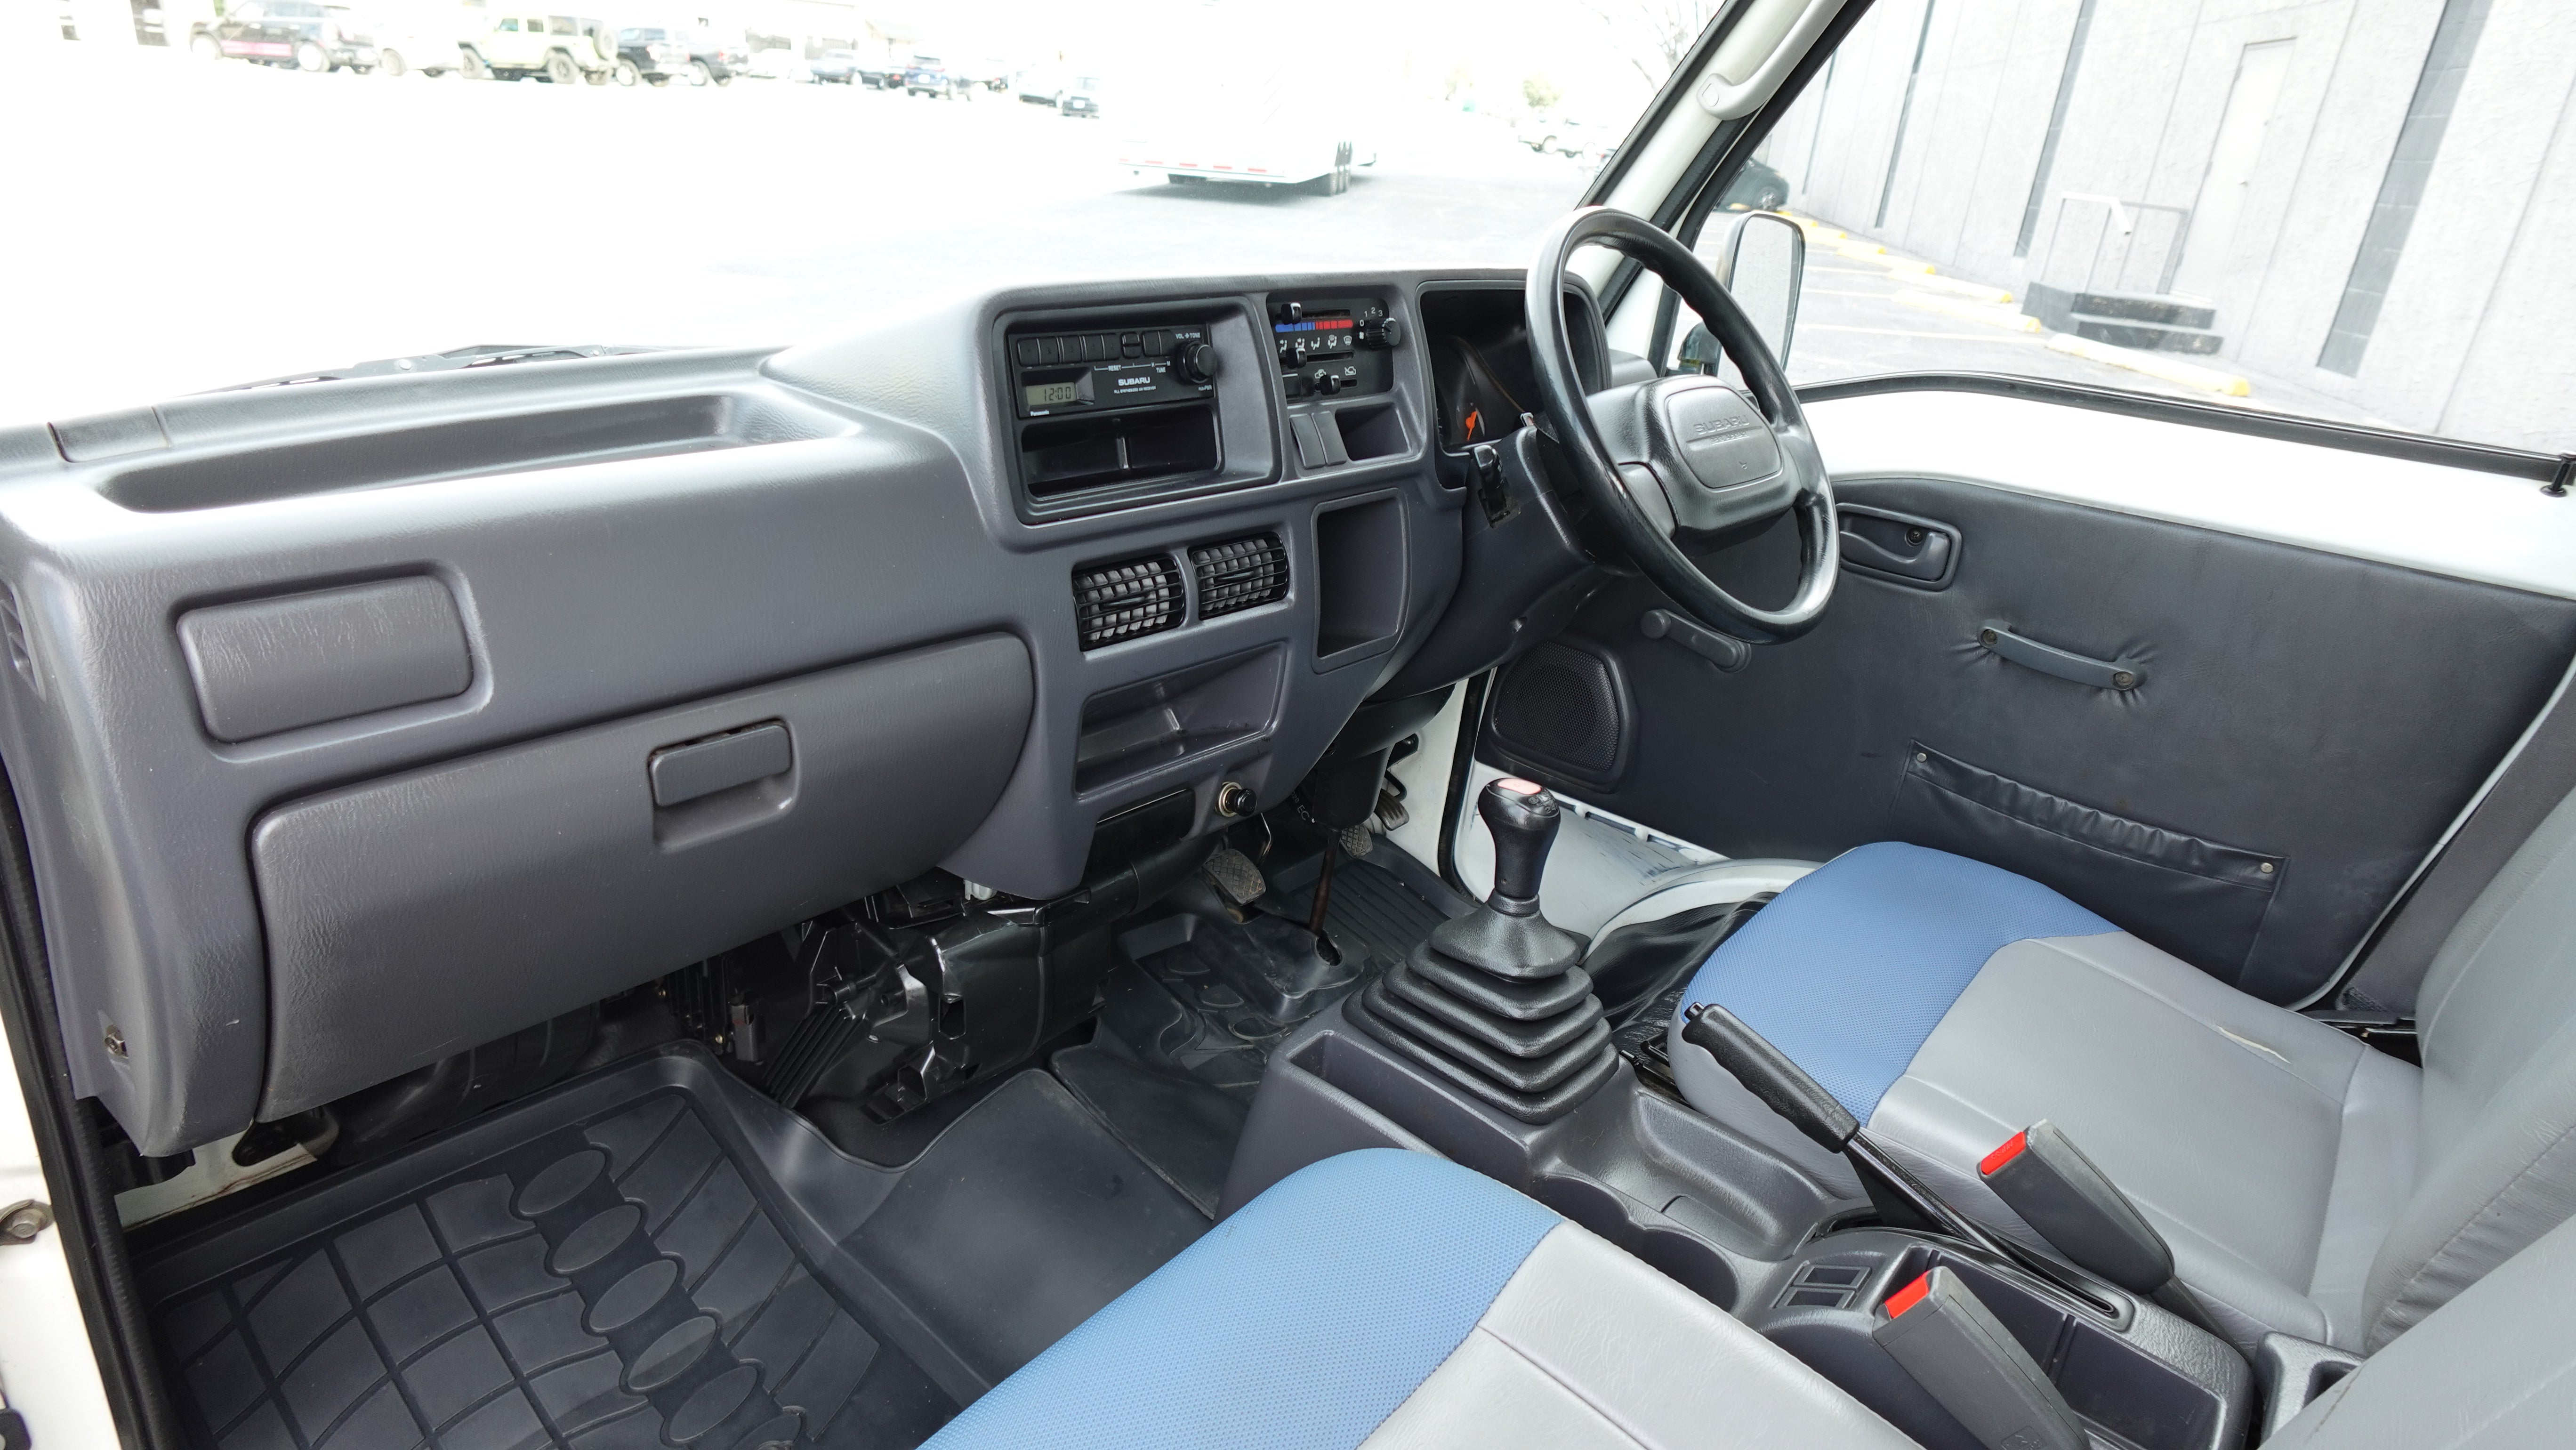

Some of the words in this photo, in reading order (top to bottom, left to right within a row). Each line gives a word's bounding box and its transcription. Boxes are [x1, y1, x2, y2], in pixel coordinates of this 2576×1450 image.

[1118, 377, 1151, 386] SUBARU
[1044, 387, 1071, 402] 12:00
[1693, 415, 1750, 435] SUBARU
